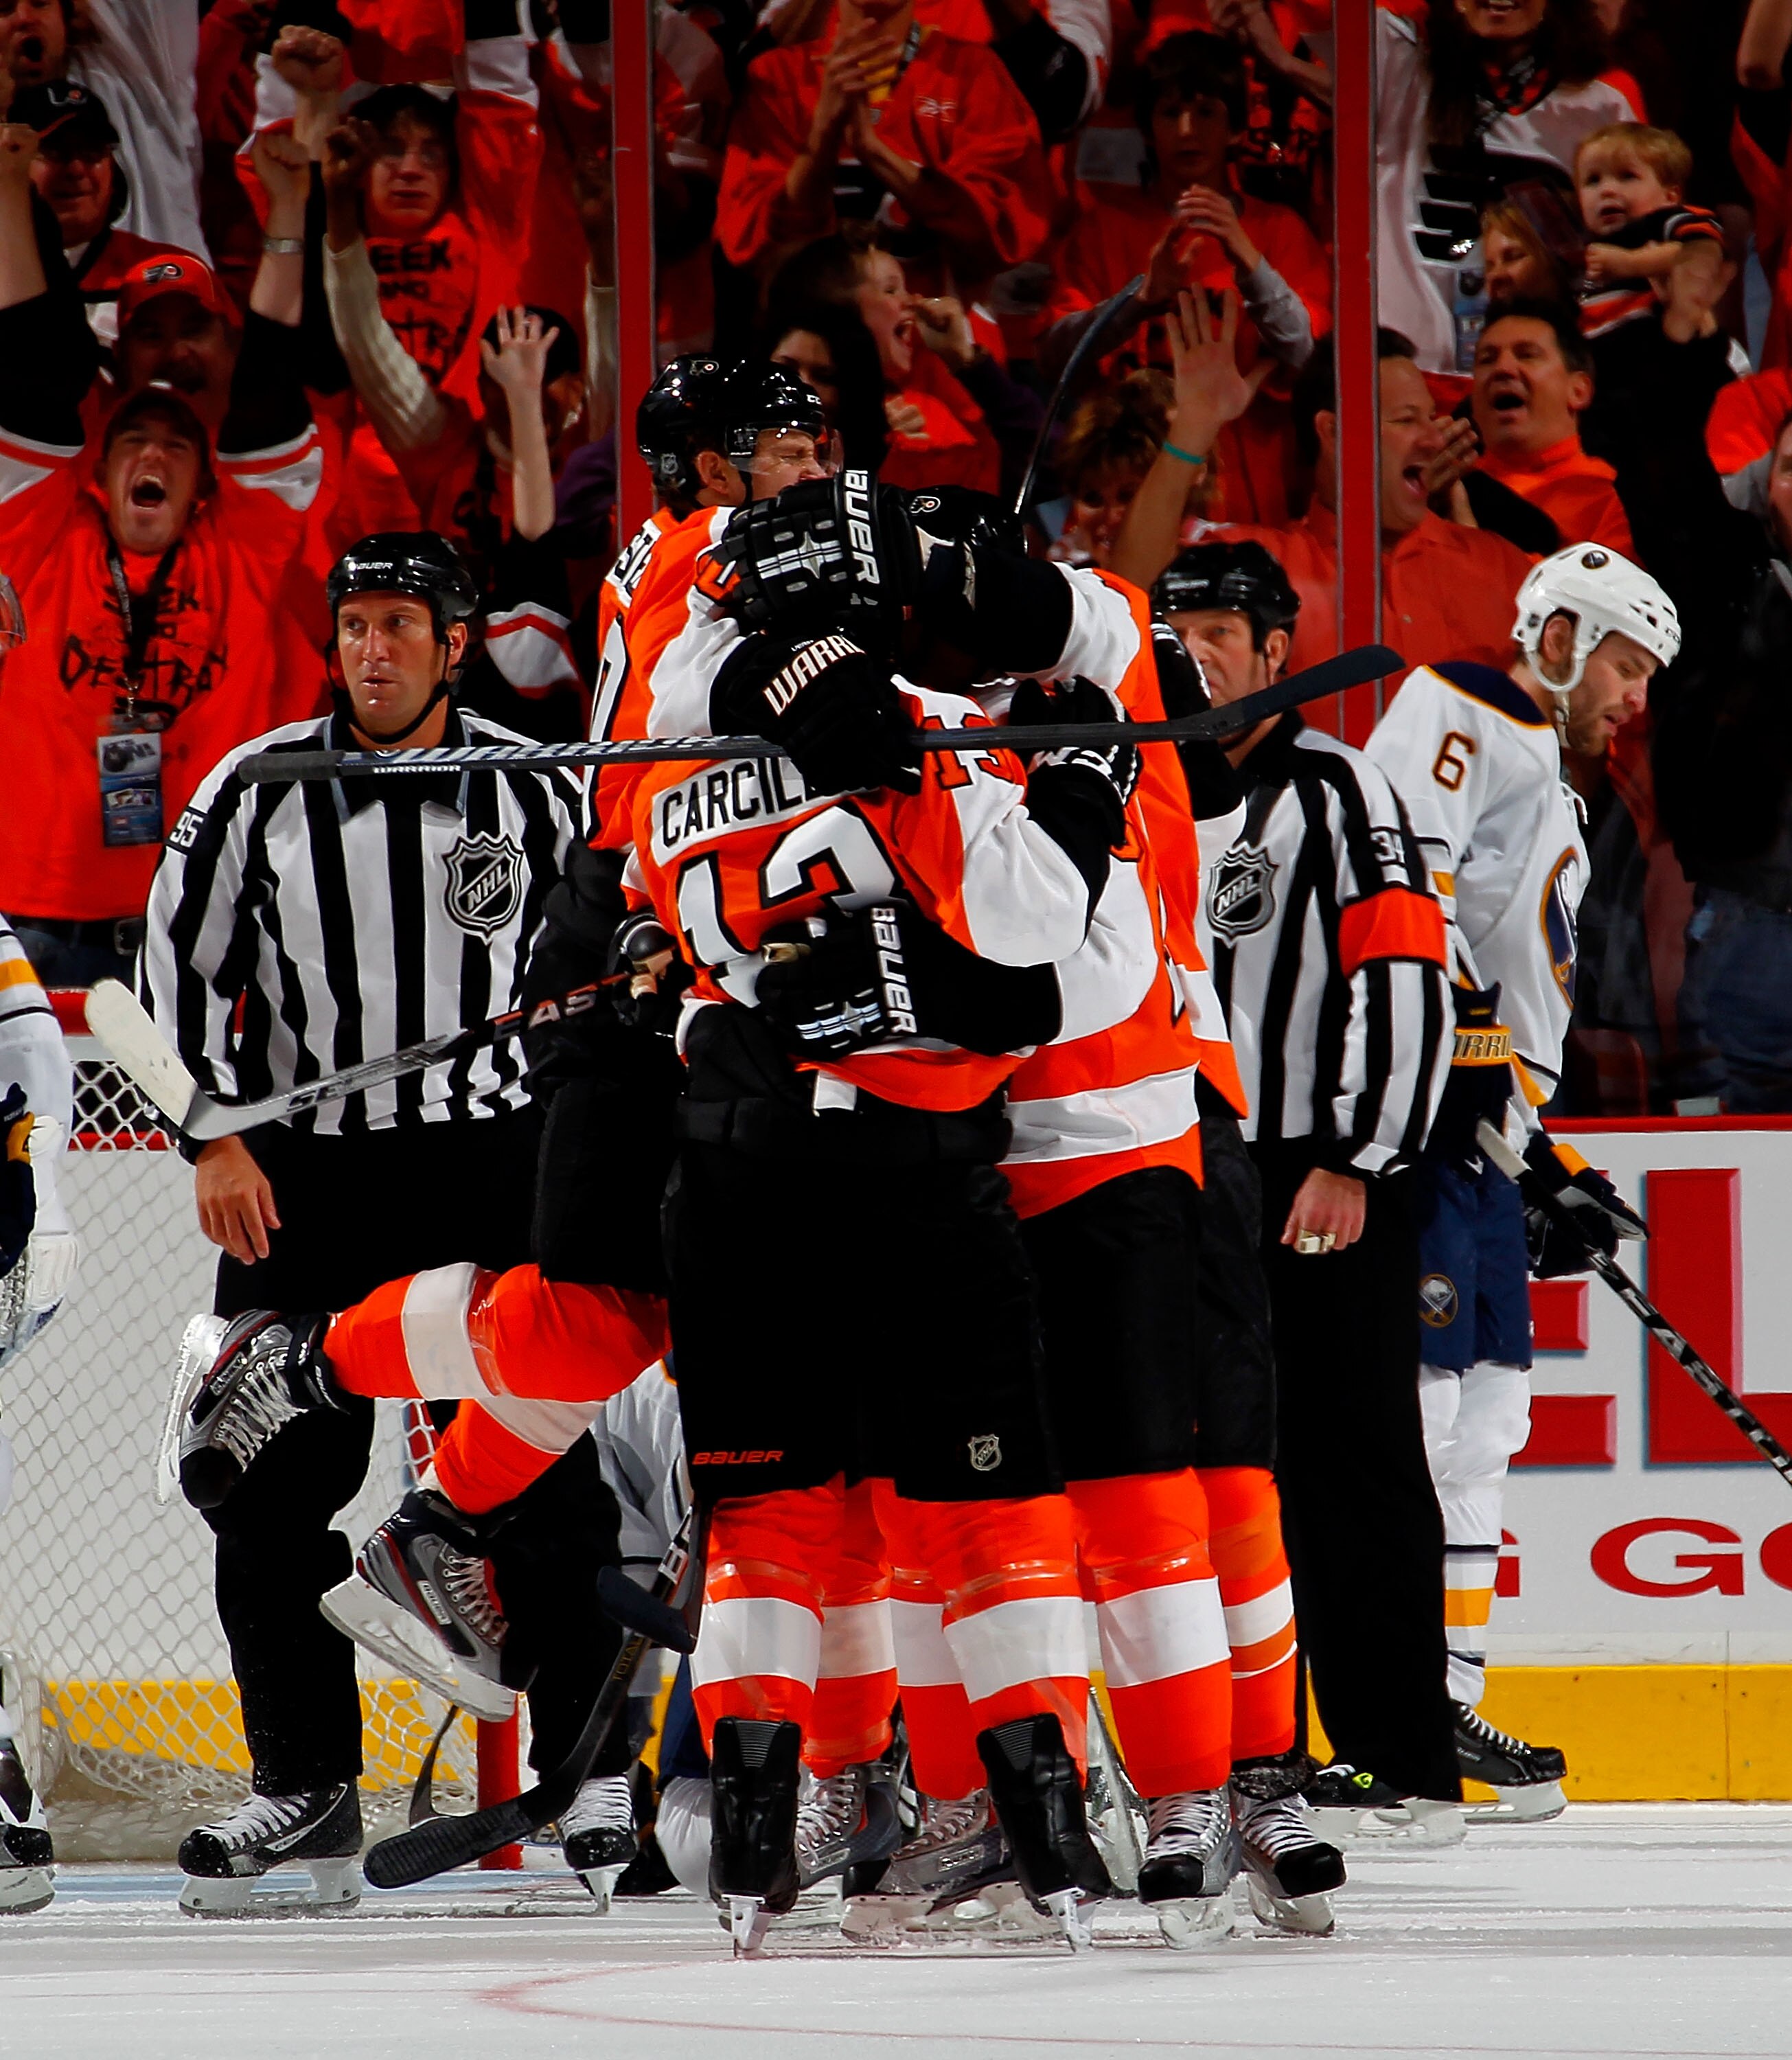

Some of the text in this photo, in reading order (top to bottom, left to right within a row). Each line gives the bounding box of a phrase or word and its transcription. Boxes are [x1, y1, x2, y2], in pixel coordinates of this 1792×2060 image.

[373, 764, 462, 775] WARRIOR
[1432, 731, 1476, 792] 6
[169, 811, 205, 848] 95
[467, 864, 508, 911] NHL
[1217, 875, 1258, 914] NHL
[869, 907, 918, 1033] BAUER
[691, 1450, 785, 1466] BAUER
